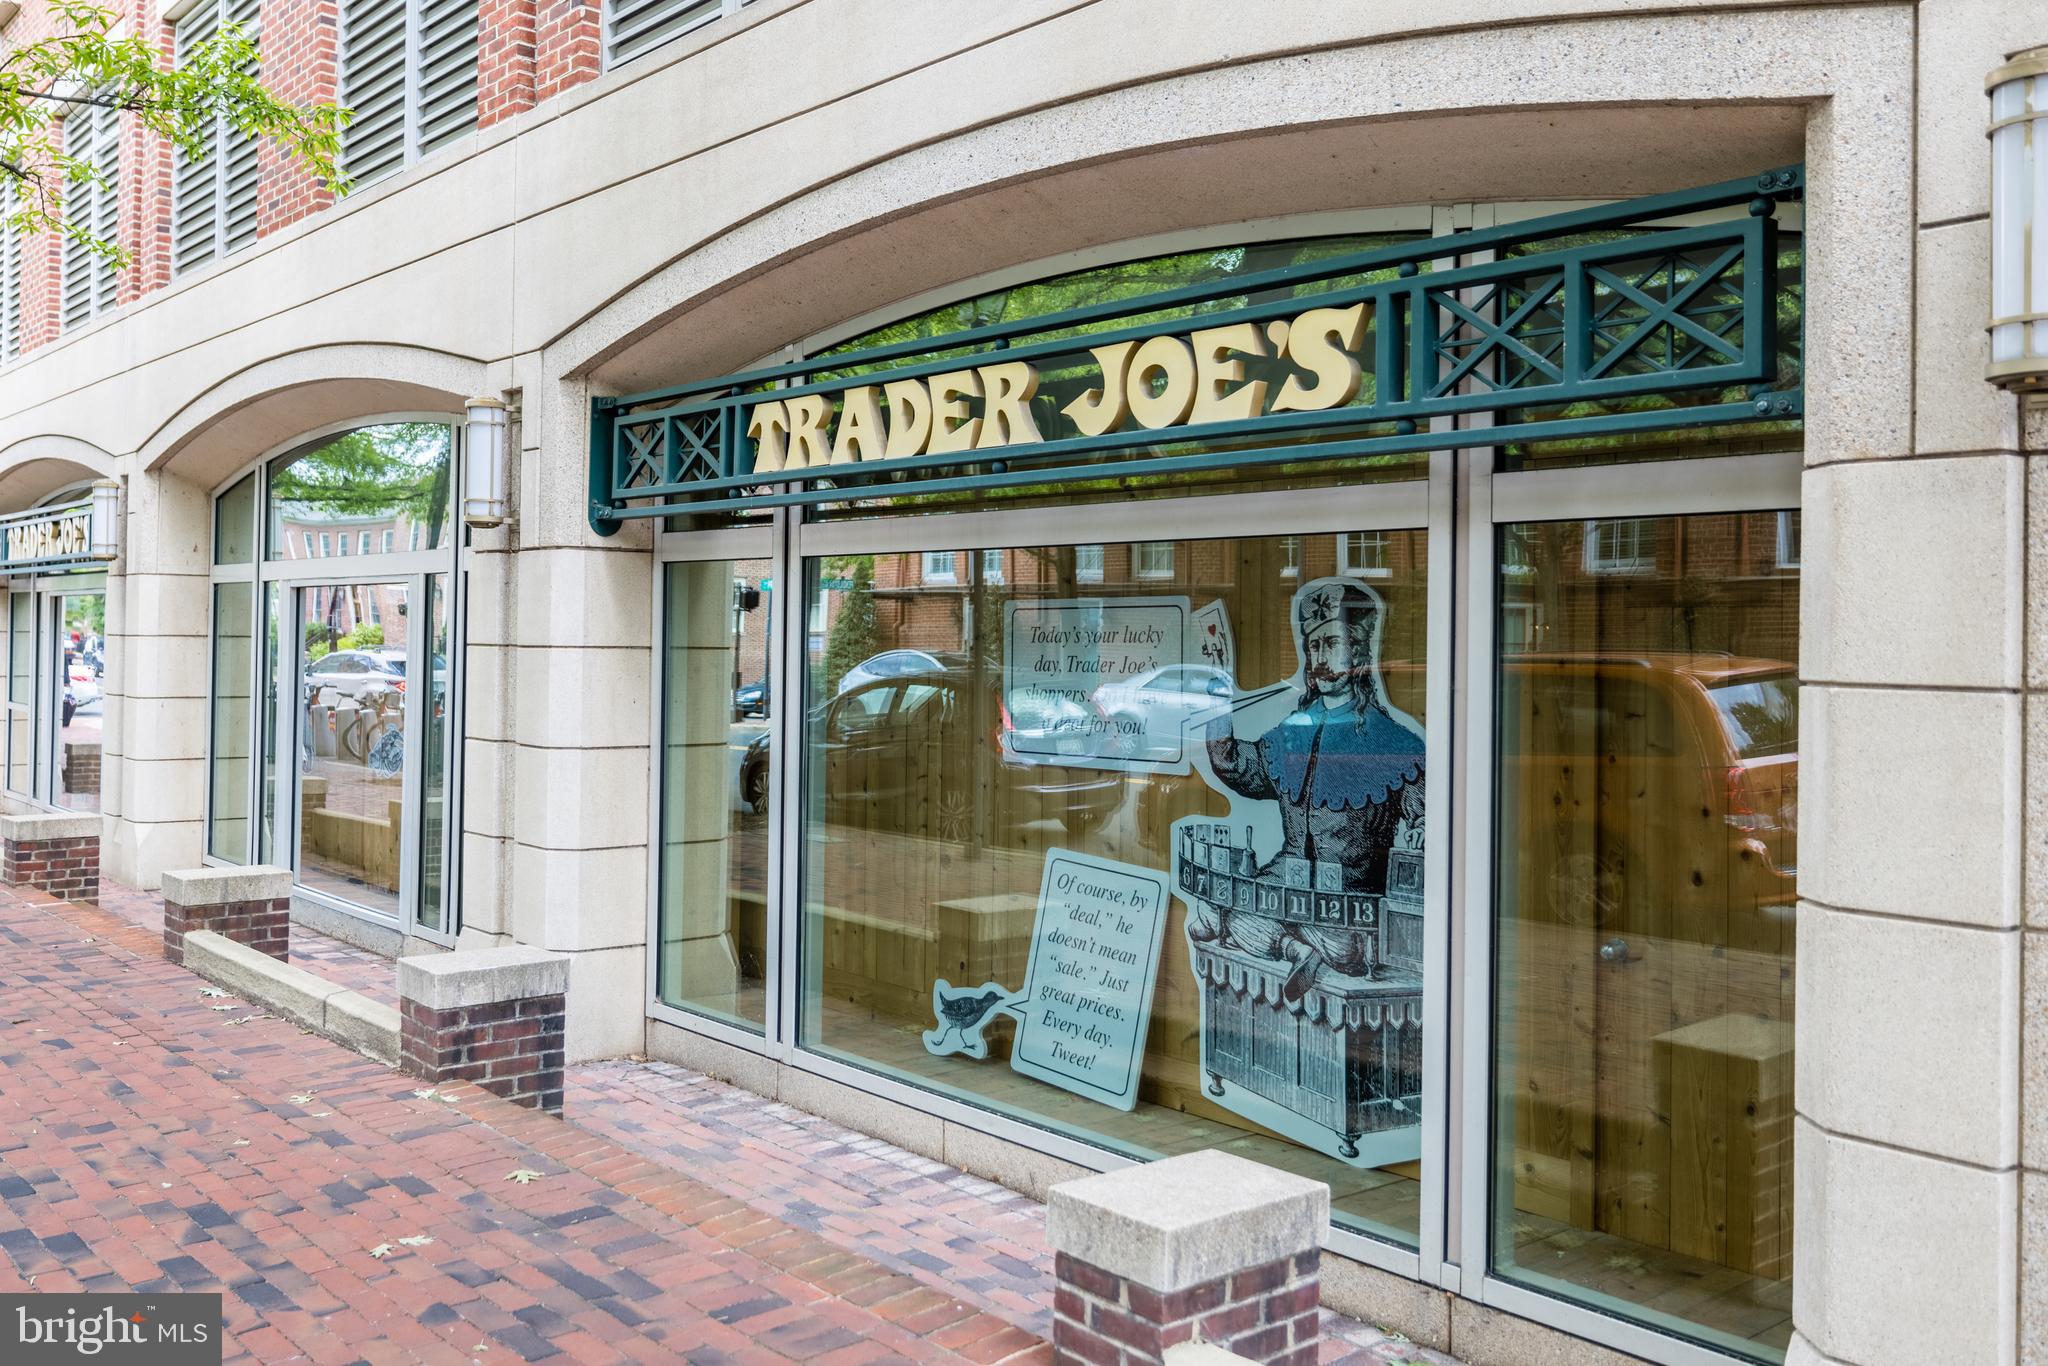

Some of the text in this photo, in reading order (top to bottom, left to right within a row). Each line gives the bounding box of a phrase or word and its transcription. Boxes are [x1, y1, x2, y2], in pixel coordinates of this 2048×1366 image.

[747, 302, 1375, 473] TRADER JOE'S
[1030, 625, 1164, 648] Today's your lucky
[1066, 655, 1116, 673] Trader
[1118, 655, 1158, 674] Joe's
[1086, 714, 1111, 737] for
[1113, 717, 1149, 738] you!
[1056, 873, 1149, 912] Of course, by
[1182, 867, 1375, 922] 6 7 8 9 10 11 12 13
[1115, 915, 1134, 935] he
[1047, 927, 1137, 966] doesn't mean
[1098, 970, 1130, 993] Just
[1039, 983, 1125, 1023] great prices.
[1041, 1009, 1113, 1048] Every day.
[1051, 1040, 1097, 1071] Tweet!
